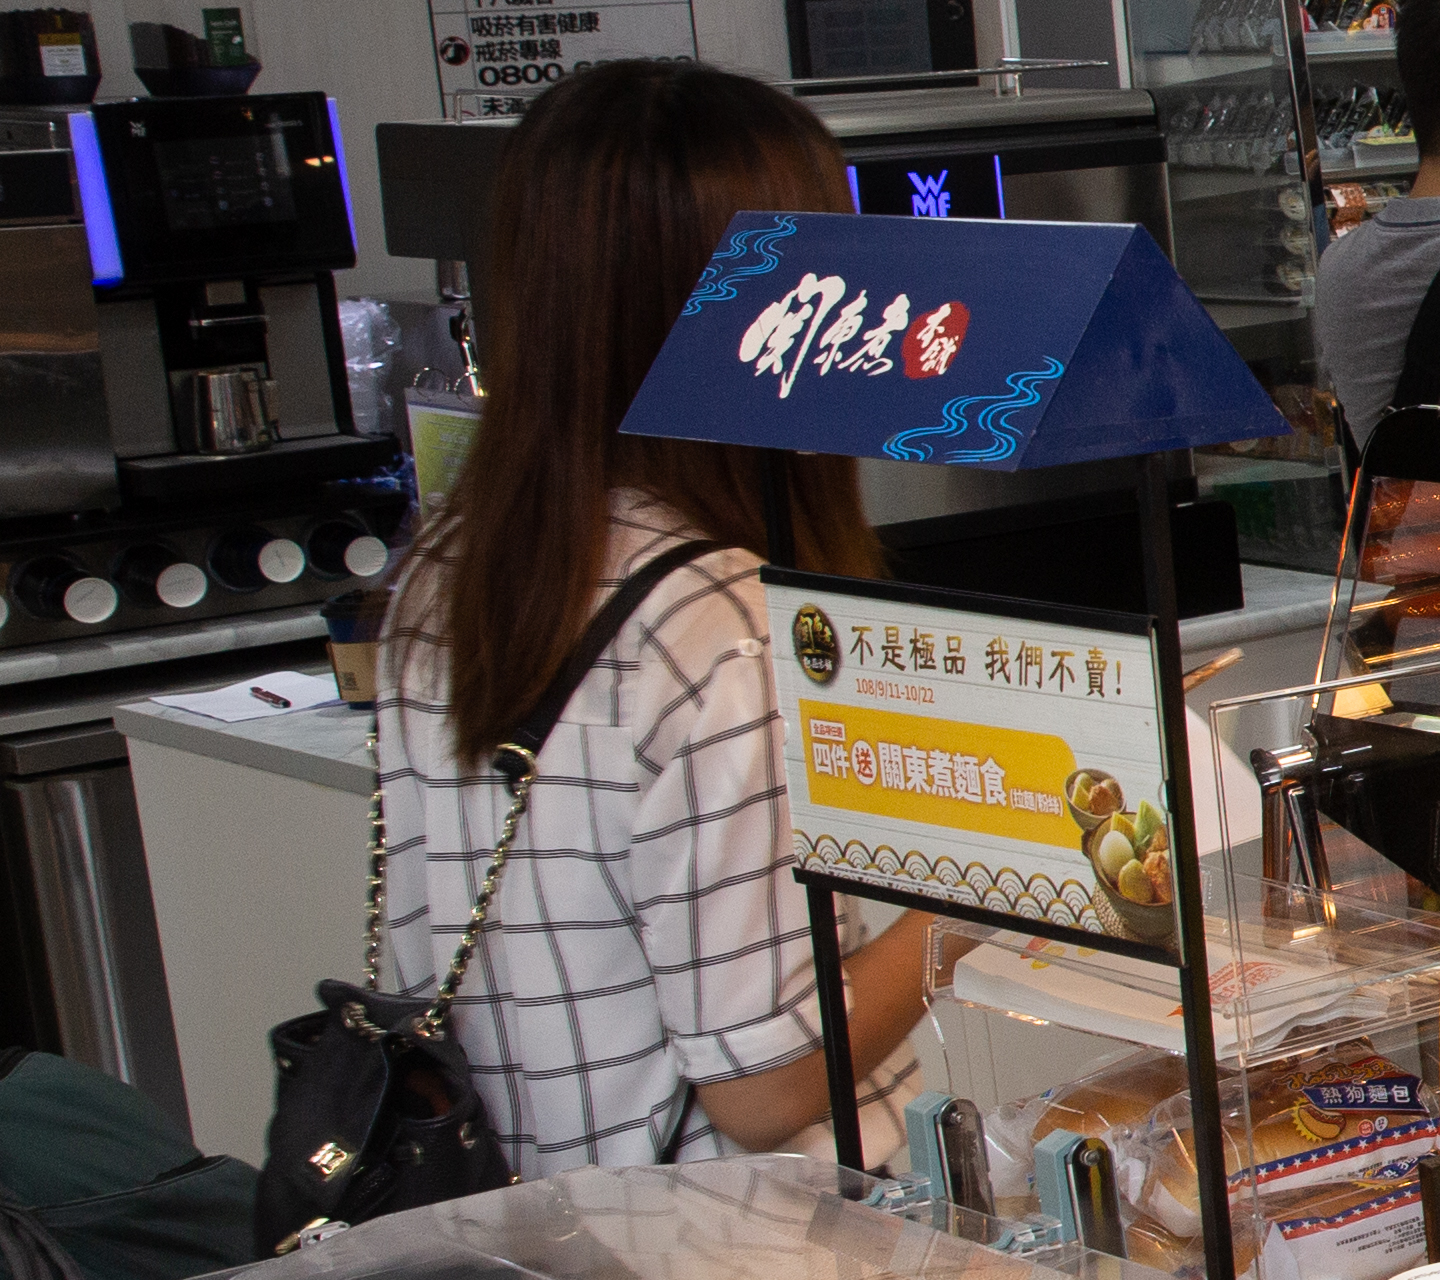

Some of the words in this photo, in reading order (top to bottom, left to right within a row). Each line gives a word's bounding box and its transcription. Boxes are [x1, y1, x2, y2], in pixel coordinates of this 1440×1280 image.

[471, 11, 600, 38] 吸菸有害健康
[475, 38, 562, 63] 戒菸專線
[850, 625, 967, 675] 不是極品
[984, 636, 1123, 698] 我們不賣!
[856, 678, 935, 704] 108/9/11-10/22
[1320, 1084, 1411, 1105] 熱狗麵包
